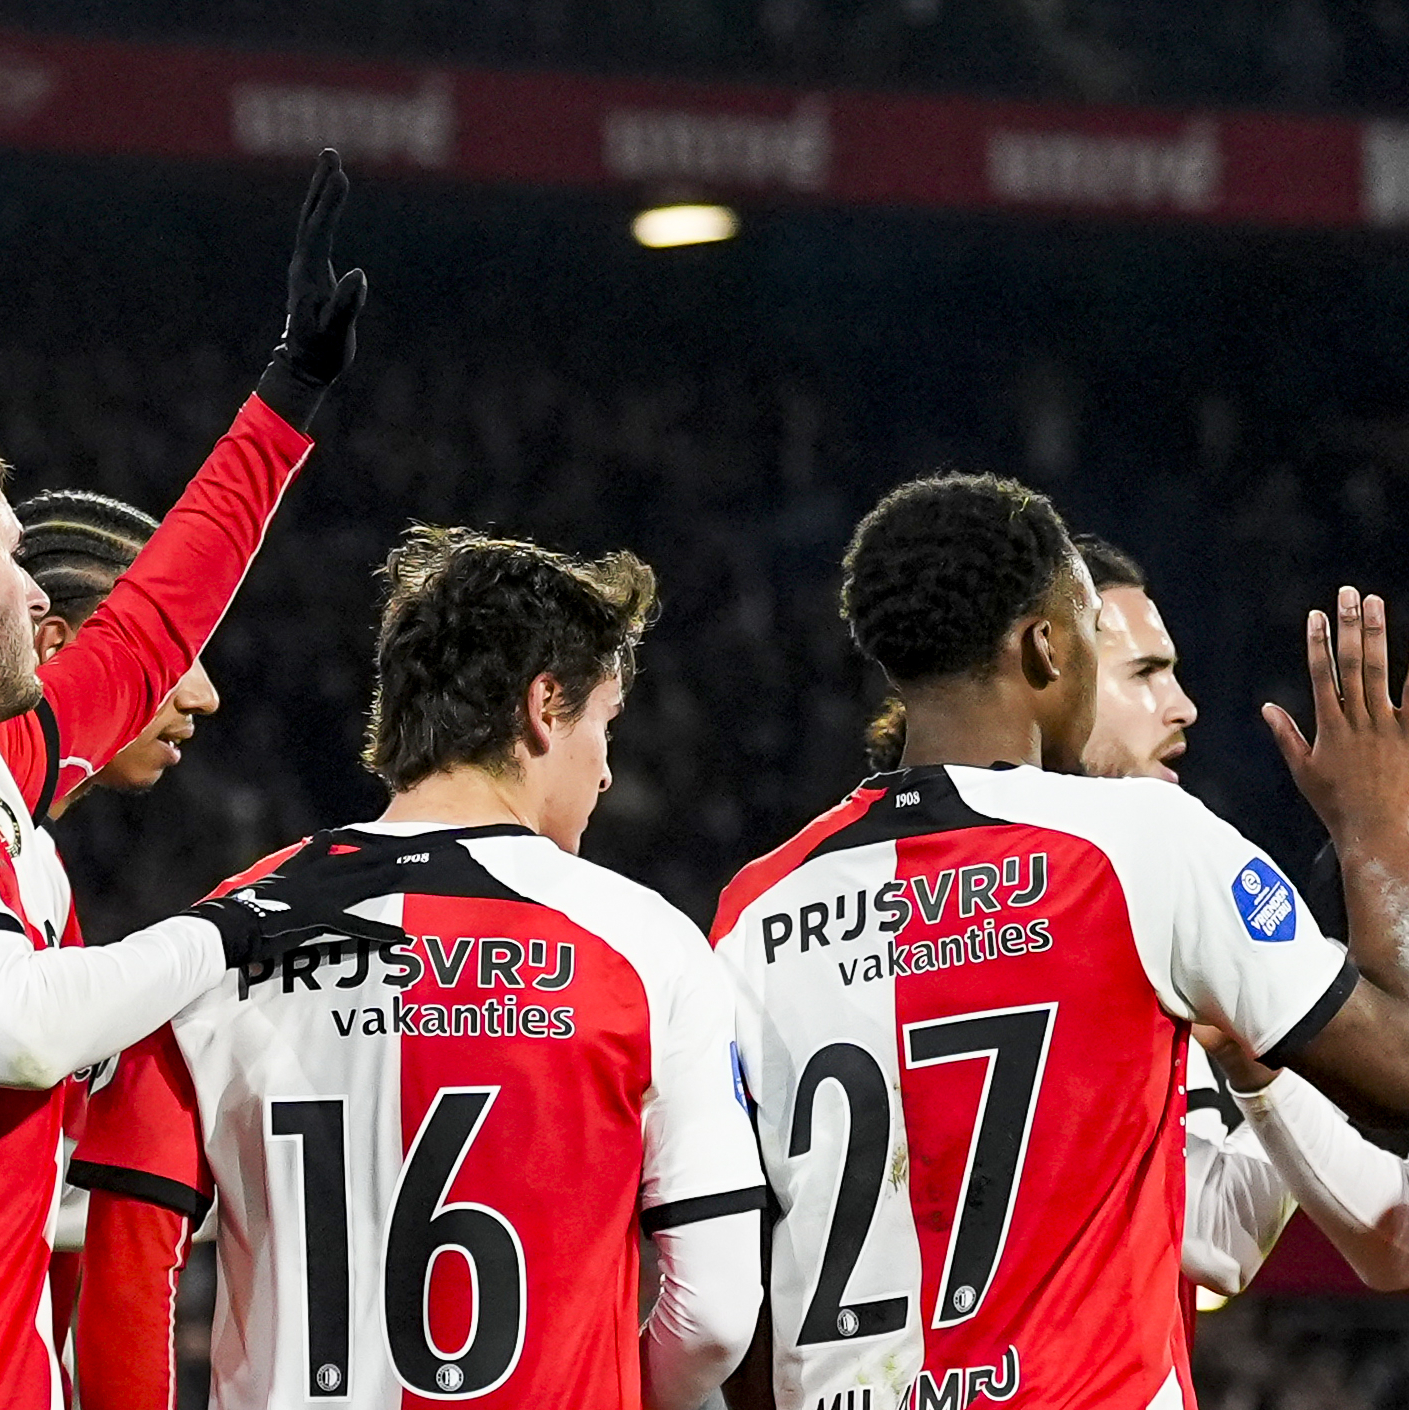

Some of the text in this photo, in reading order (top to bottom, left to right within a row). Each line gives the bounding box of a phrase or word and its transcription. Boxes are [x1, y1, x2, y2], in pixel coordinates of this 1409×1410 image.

[895, 790, 921, 808] 1908
[838, 918, 1053, 987] vakanties
[331, 995, 575, 1039] vakanties
[788, 1002, 1059, 1348] 27
[264, 1085, 528, 1402] 16
